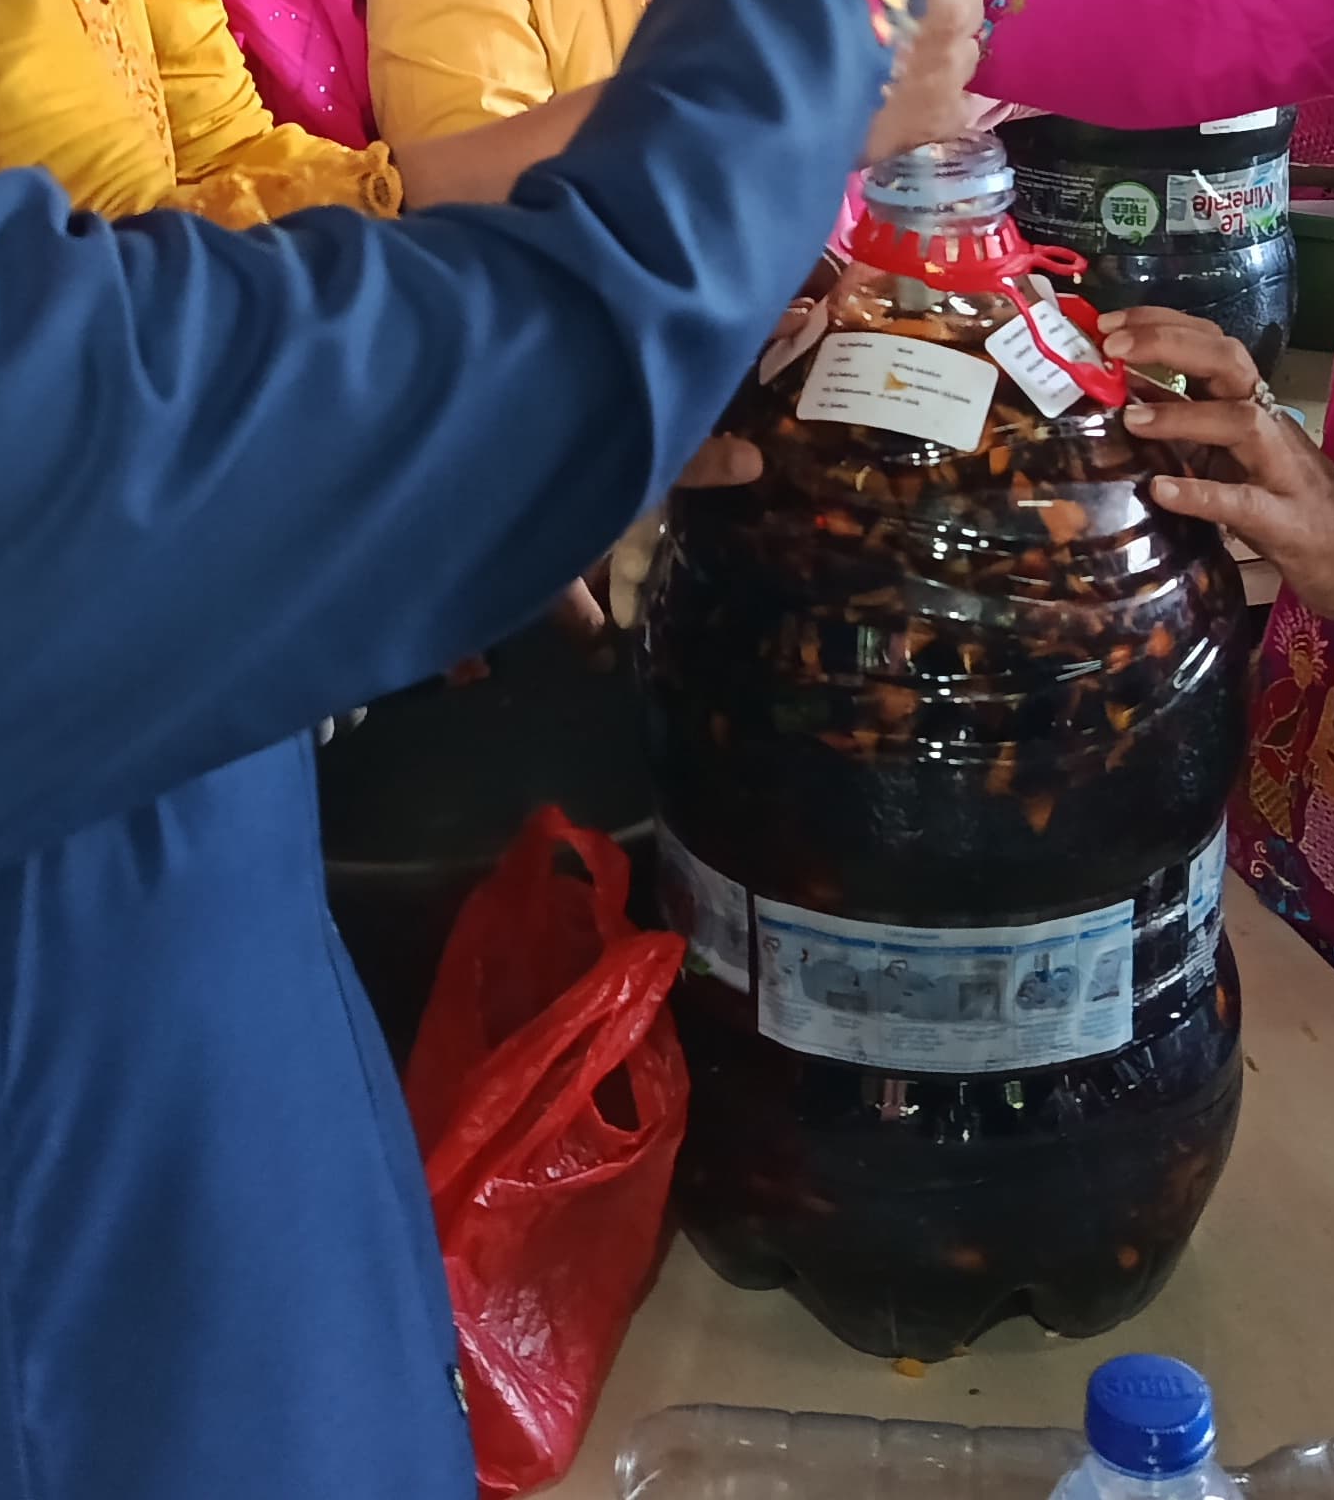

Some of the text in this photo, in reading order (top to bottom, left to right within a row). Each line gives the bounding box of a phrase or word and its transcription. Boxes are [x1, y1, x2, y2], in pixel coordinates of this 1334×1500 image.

[1112, 203, 1147, 214] FREE
[1112, 214, 1147, 227] BPA
[1220, 212, 1244, 236] Le
